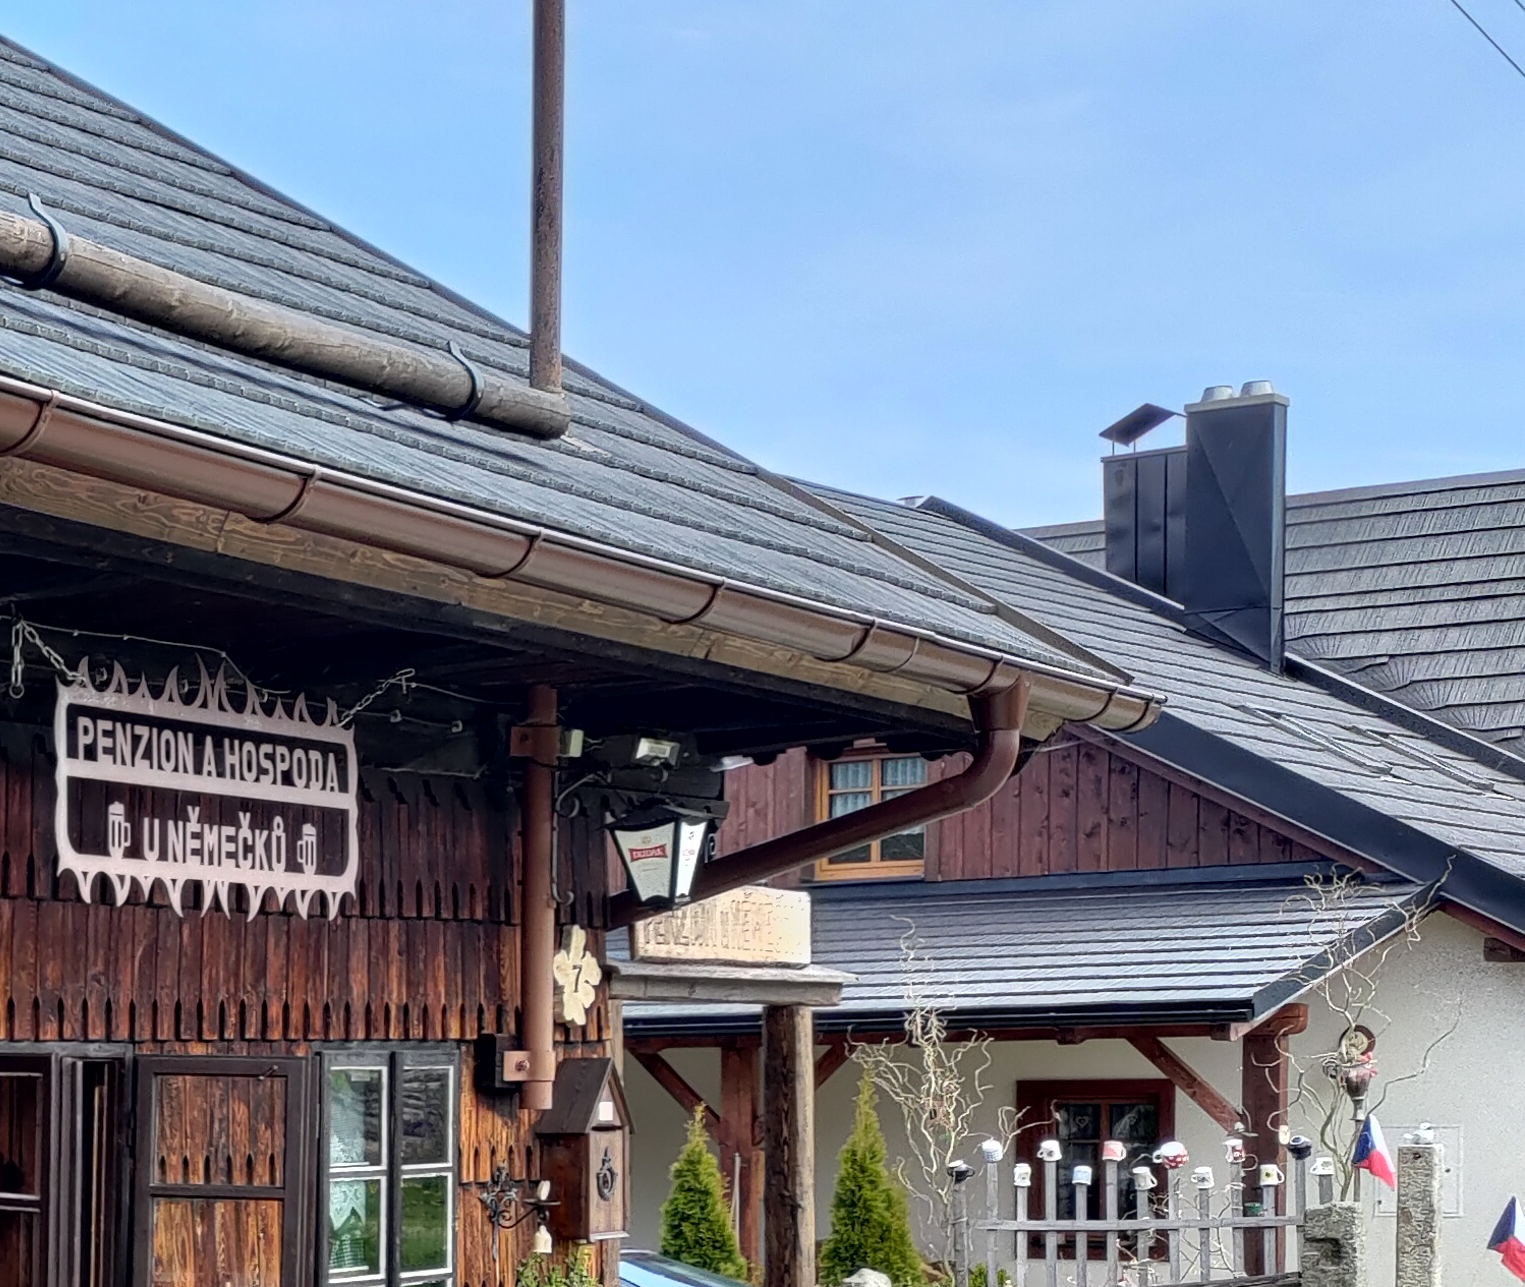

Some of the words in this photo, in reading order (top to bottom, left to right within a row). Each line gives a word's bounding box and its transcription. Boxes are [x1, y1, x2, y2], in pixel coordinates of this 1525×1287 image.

[77, 715, 195, 777] PENZION
[201, 734, 218, 780] A
[224, 737, 341, 794] HOSPODA
[143, 816, 160, 862] U
[167, 804, 287, 874] NĚMEČKŮ
[572, 964, 583, 993] 7
